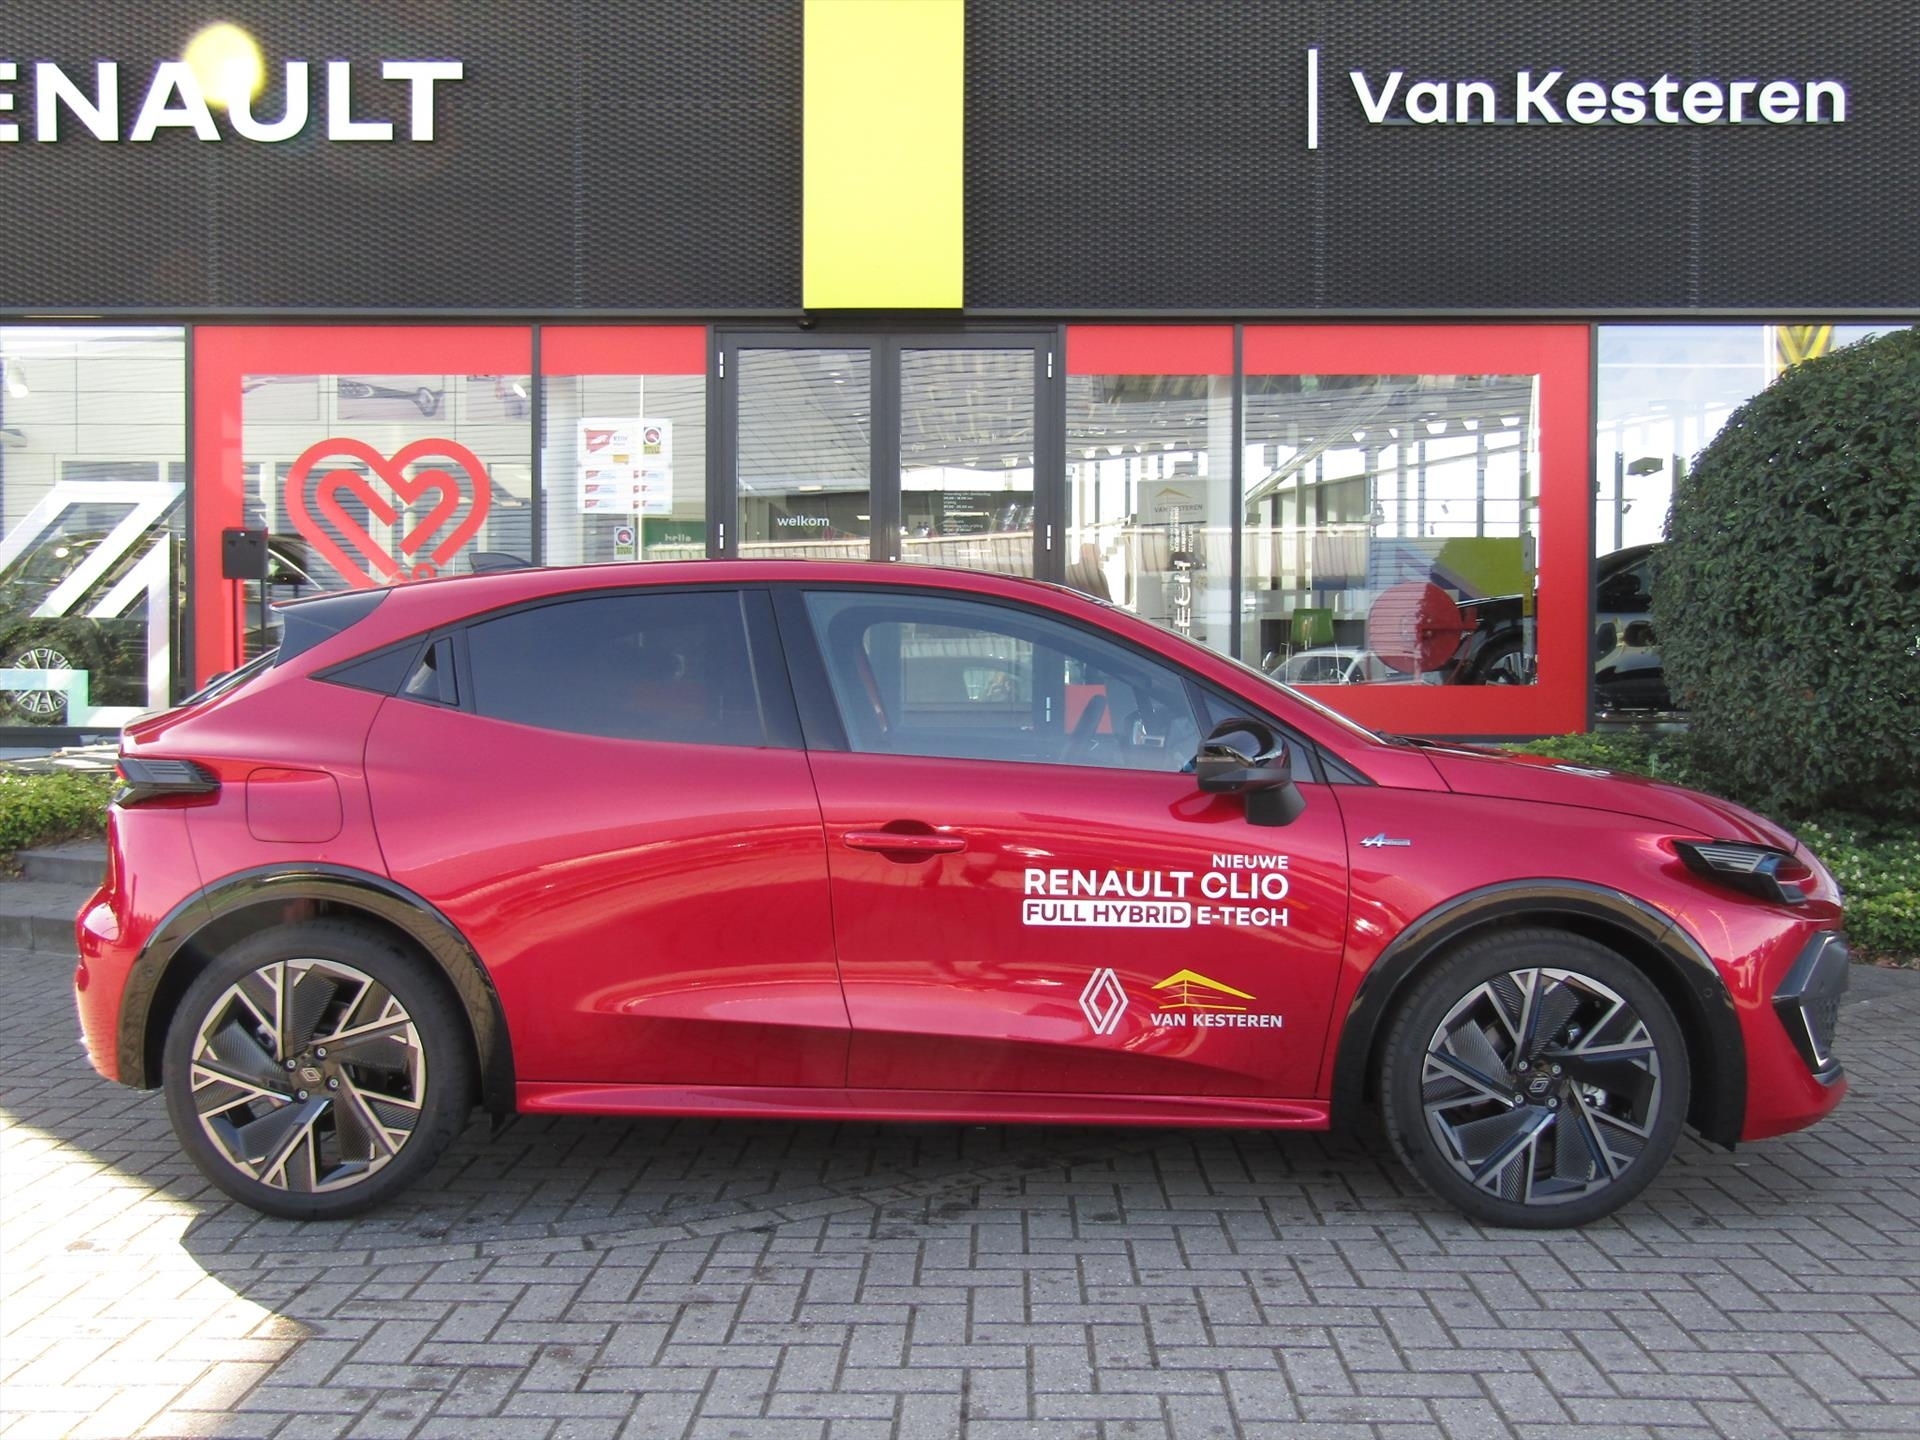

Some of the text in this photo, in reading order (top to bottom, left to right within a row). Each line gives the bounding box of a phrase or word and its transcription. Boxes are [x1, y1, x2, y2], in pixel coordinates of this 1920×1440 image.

[1349, 71, 1846, 124] Van Kesteren
[777, 515, 830, 527] welkom
[1212, 854, 1289, 870] NIEUWE
[1024, 868, 1289, 900] RENAULT CLIO
[1026, 903, 1289, 927] FULL HYBRID E-TECH
[1151, 1013, 1283, 1028] VAN KESTEREN
